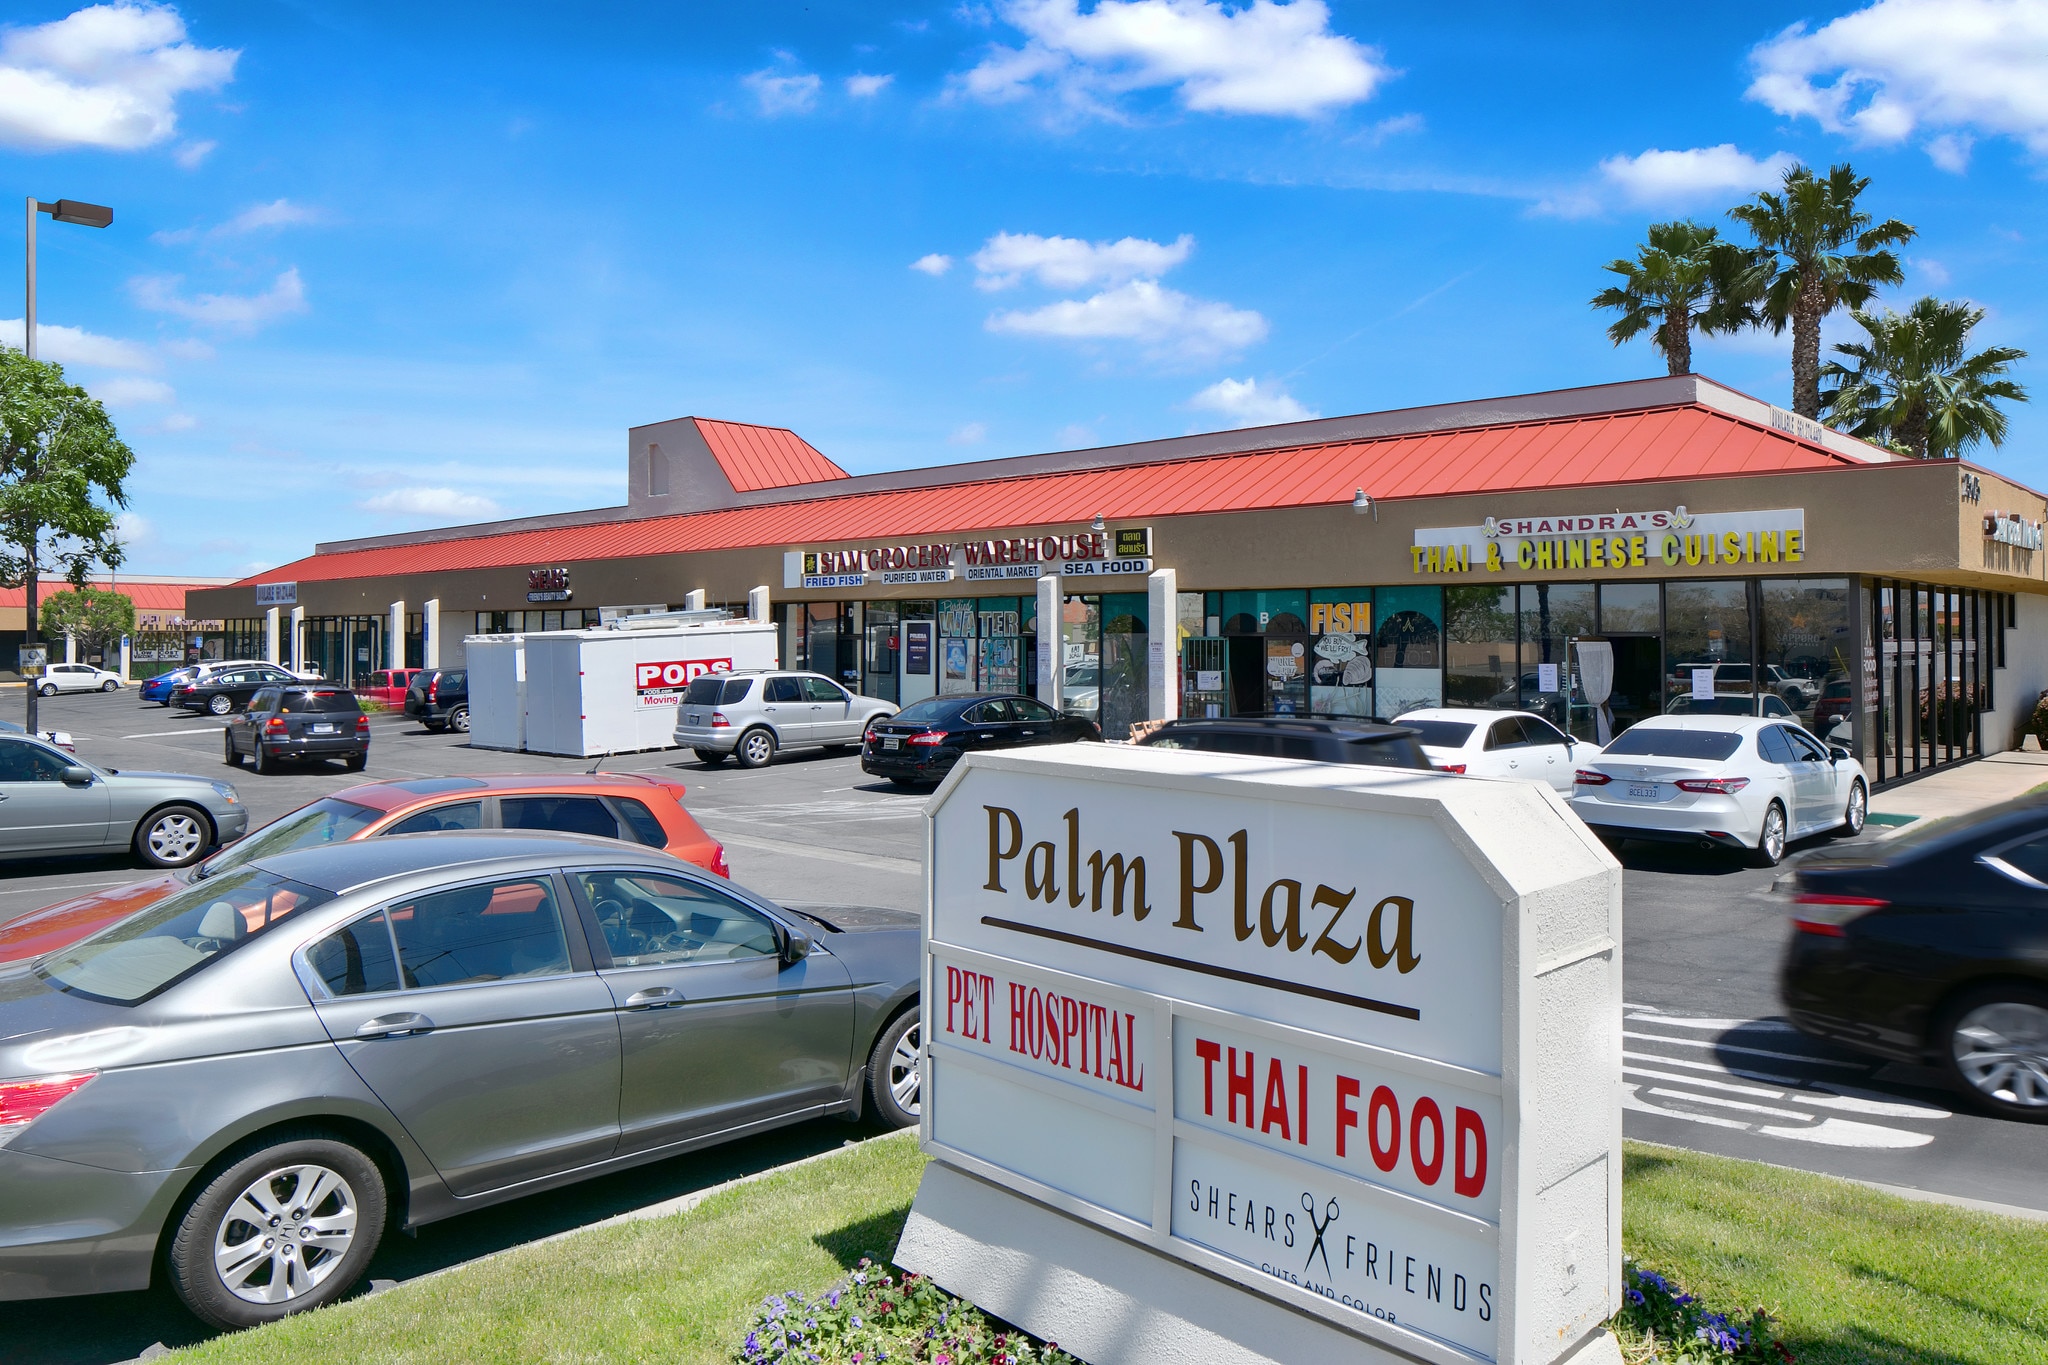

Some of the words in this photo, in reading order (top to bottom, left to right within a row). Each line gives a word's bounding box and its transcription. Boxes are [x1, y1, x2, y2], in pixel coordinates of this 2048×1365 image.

[1499, 513, 1668, 535] SHANDRA'S
[820, 550, 863, 574] SIAM
[867, 543, 953, 572] GROCERY
[963, 533, 1105, 566] WAREHOUSE
[1410, 544, 1469, 573] THAI
[1486, 541, 1501, 572] &
[1517, 535, 1646, 570] CHINESE
[1661, 529, 1802, 567] CUISINE
[968, 567, 1004, 579] ORIENTAL
[1006, 566, 1039, 577] MARKET
[1064, 563, 1095, 574] SEA
[1101, 560, 1144, 573] FOOD
[805, 577, 836, 587] FRIED
[838, 575, 863, 585] FISH
[883, 573, 917, 583] PURIFIED
[919, 571, 946, 582] WATER
[848, 608, 854, 617] D
[1260, 612, 1269, 624] B
[1310, 602, 1371, 635] FISH
[140, 614, 160, 627] PET
[939, 611, 1019, 638] WATER
[1323, 637, 1332, 645] YOU
[1776, 632, 1820, 643] SAPPORO
[1384, 650, 1433, 666] FOOD
[644, 695, 678, 705] Moving
[1629, 788, 1657, 798] 8CEL333
[982, 804, 1152, 922] Palm
[1172, 828, 1421, 974] Plaza
[945, 965, 994, 1044] PET
[1008, 981, 1144, 1092] HOSPITAL
[1196, 1038, 1308, 1146] THAI
[1336, 1074, 1488, 1199] FOOD
[1190, 1179, 1295, 1248] SHEARS
[1346, 1235, 1492, 1322] FRIENDS
[1261, 1262, 1298, 1285] CUTS
[1304, 1280, 1335, 1300] AND
[1342, 1294, 1396, 1324] COLOR
